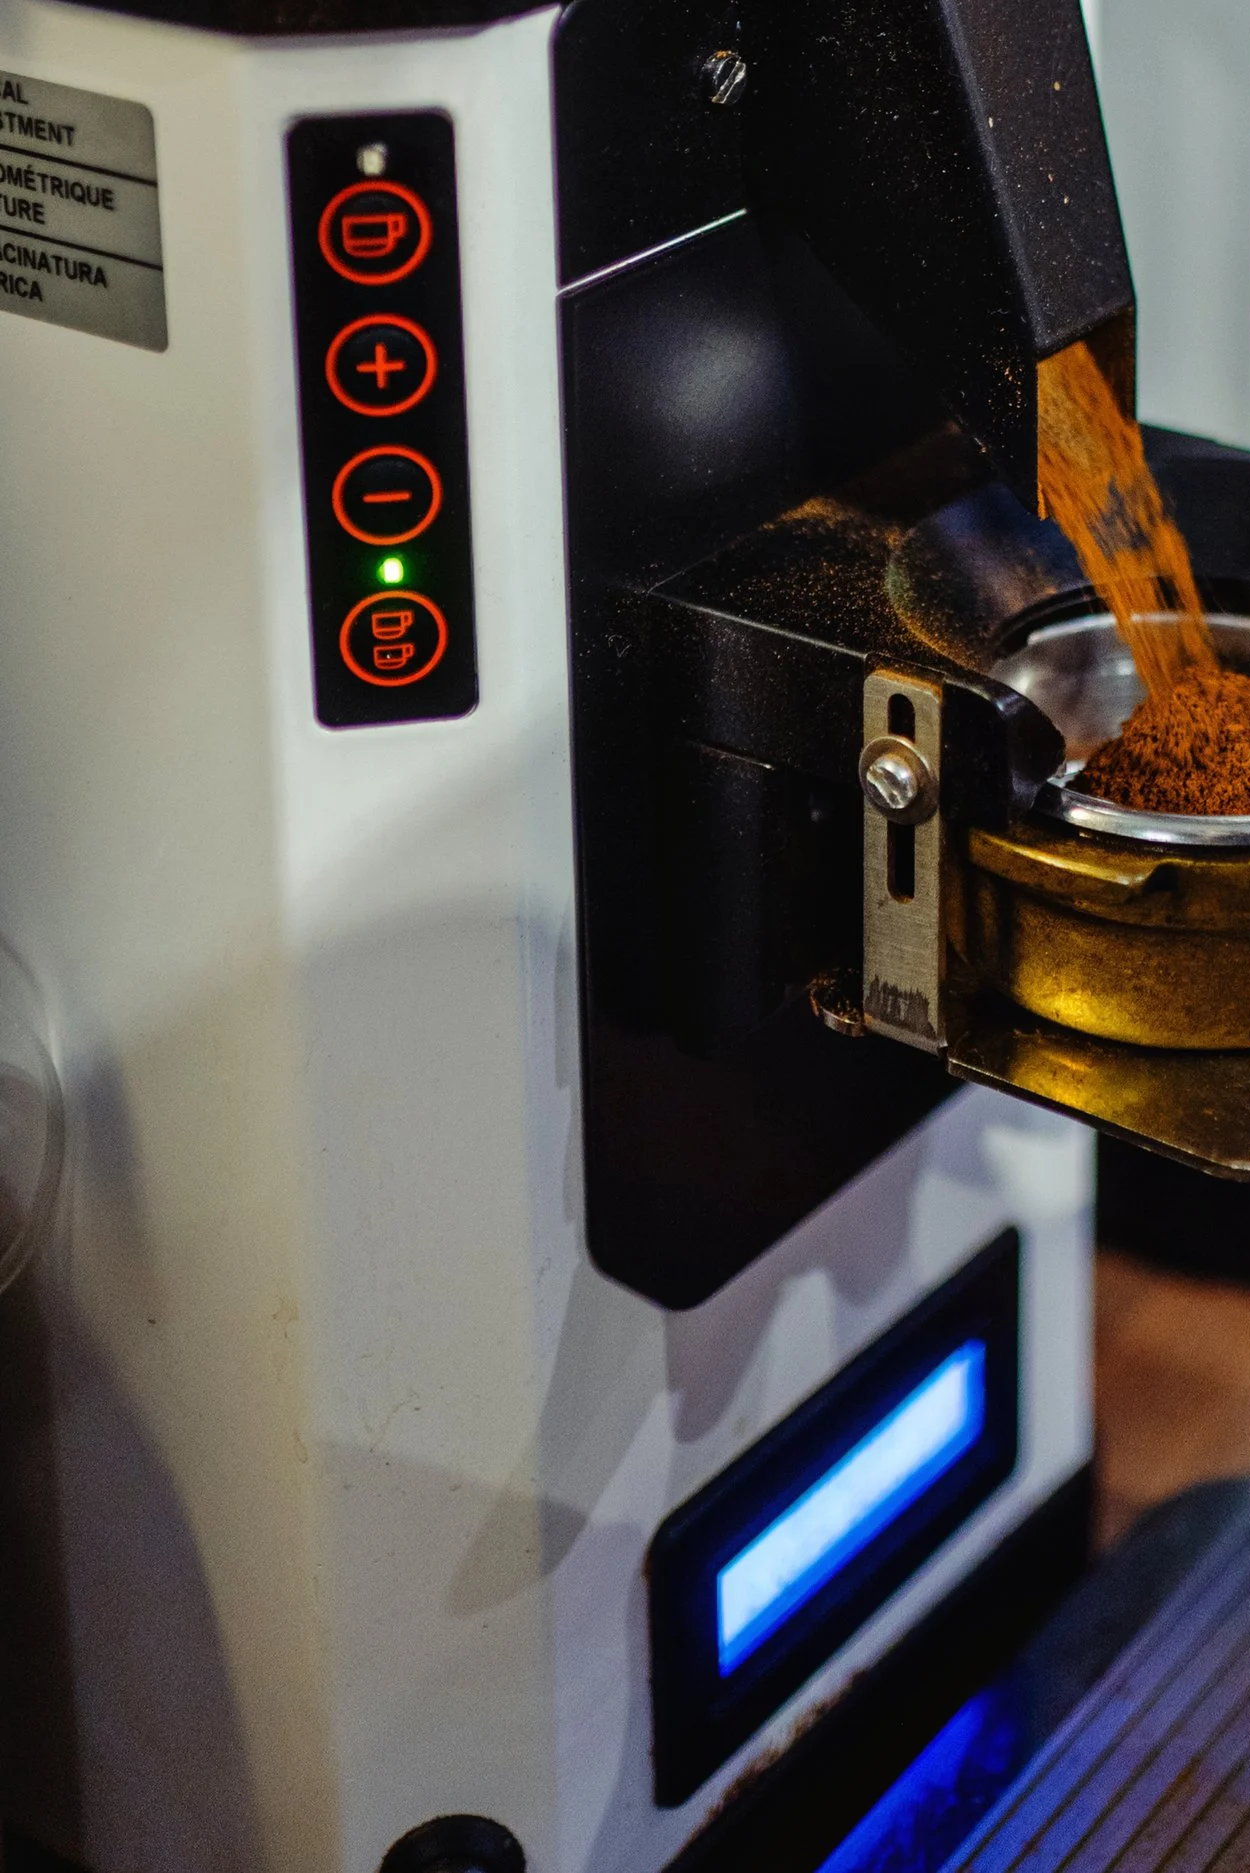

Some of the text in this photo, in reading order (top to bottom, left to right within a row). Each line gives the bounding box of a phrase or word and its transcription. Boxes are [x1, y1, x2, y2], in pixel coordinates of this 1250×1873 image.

[0, 80, 29, 105] AL
[0, 193, 45, 225] URE
[0, 242, 108, 288] CINATURA
